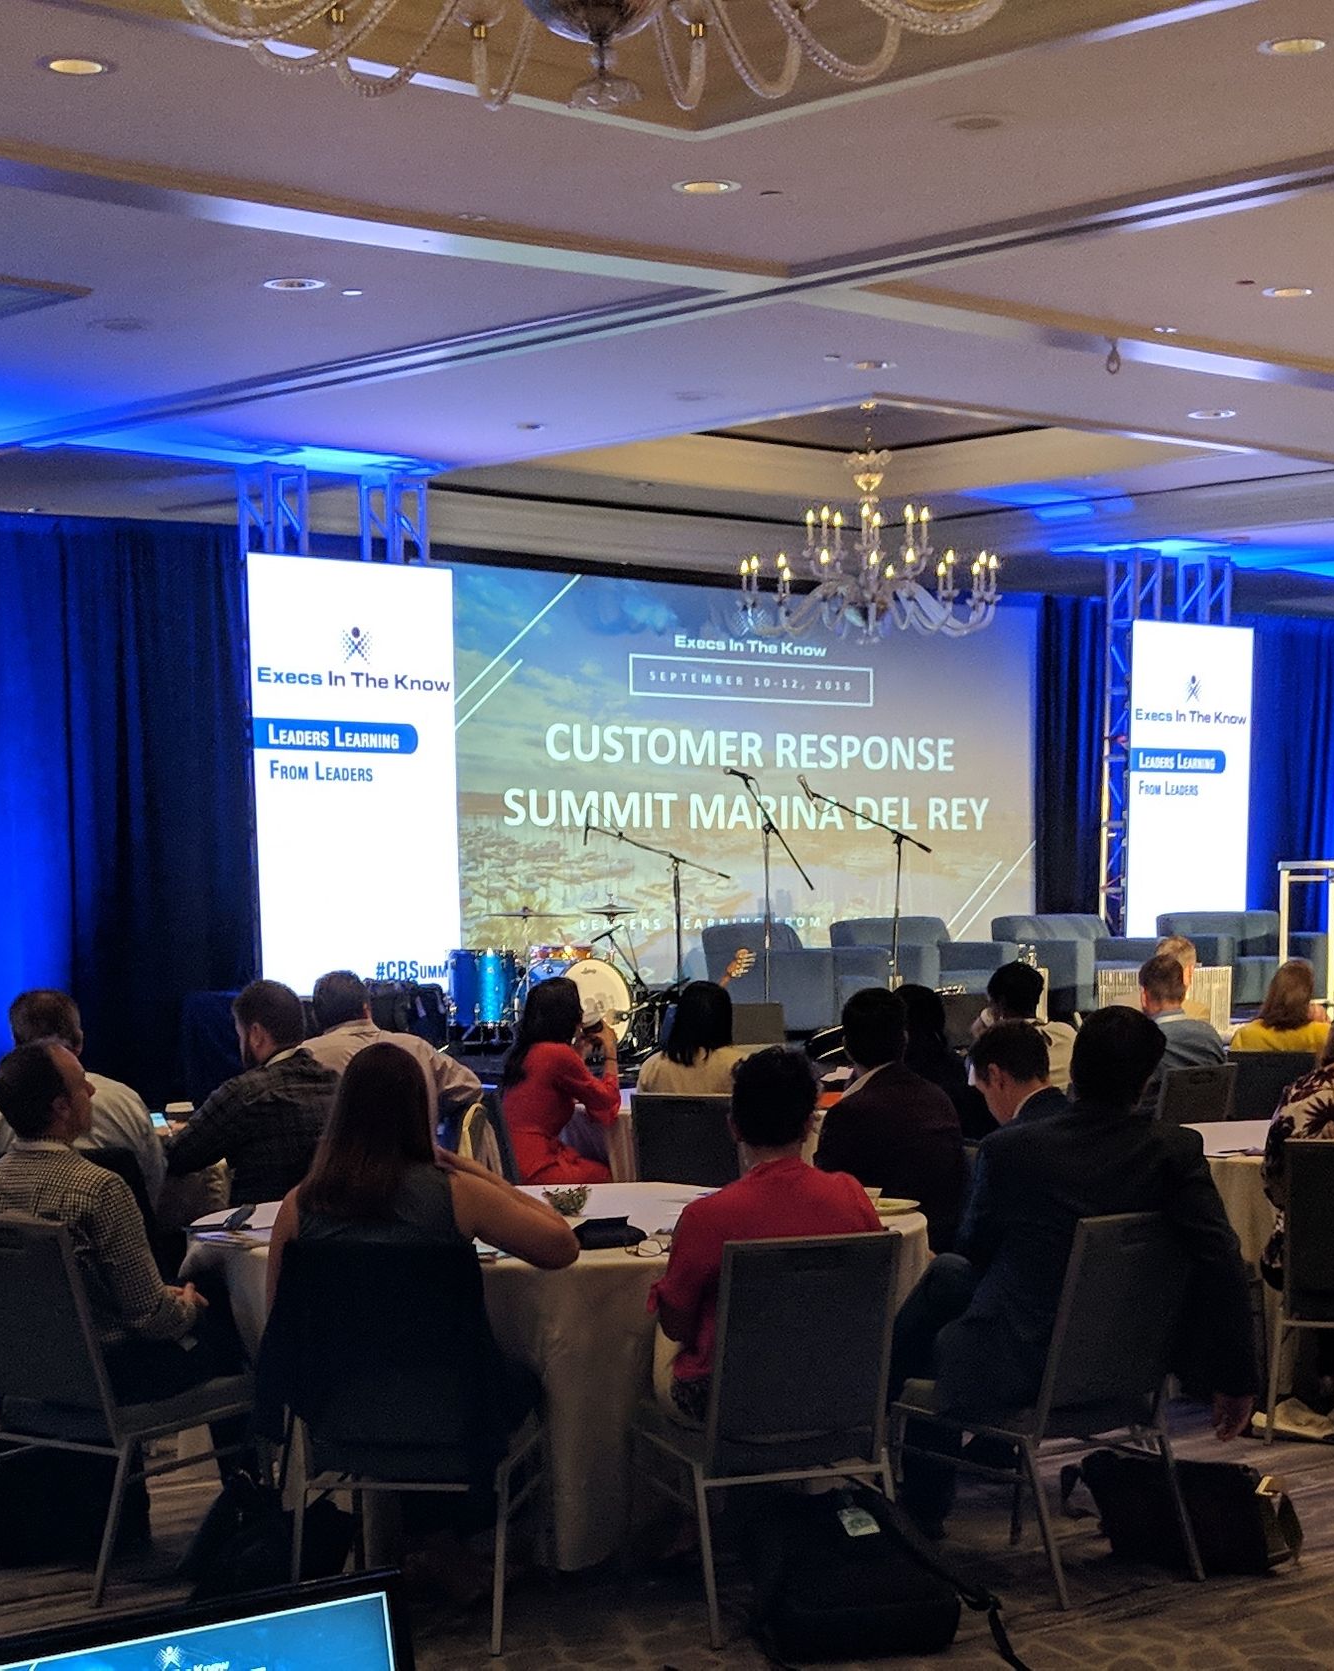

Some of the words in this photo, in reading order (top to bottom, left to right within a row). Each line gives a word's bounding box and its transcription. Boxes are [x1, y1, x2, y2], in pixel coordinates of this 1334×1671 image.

[674, 634, 726, 651] Execs
[730, 638, 744, 652] In
[747, 639, 778, 654] The
[781, 642, 828, 657] Know
[257, 666, 323, 686] Execs
[328, 670, 346, 687] In
[350, 671, 389, 689] The
[394, 674, 451, 692] Know
[649, 671, 744, 686] SEPTEMBER
[754, 677, 806, 691] 10-12,
[1135, 708, 1173, 722] Execs
[1176, 709, 1186, 722] In
[1189, 710, 1211, 723] The
[1213, 711, 1247, 725] Know
[268, 723, 330, 747] LEADERS
[334, 726, 400, 750] LEARNING
[545, 722, 764, 768] CUSTOMER
[775, 732, 955, 772] RESPONSE
[269, 759, 309, 780] FROM
[314, 761, 374, 783] LEADERS
[503, 787, 678, 829] SUMMIT
[689, 792, 845, 831] MARINA
[854, 796, 918, 831] DEL
[928, 797, 990, 832] REY
